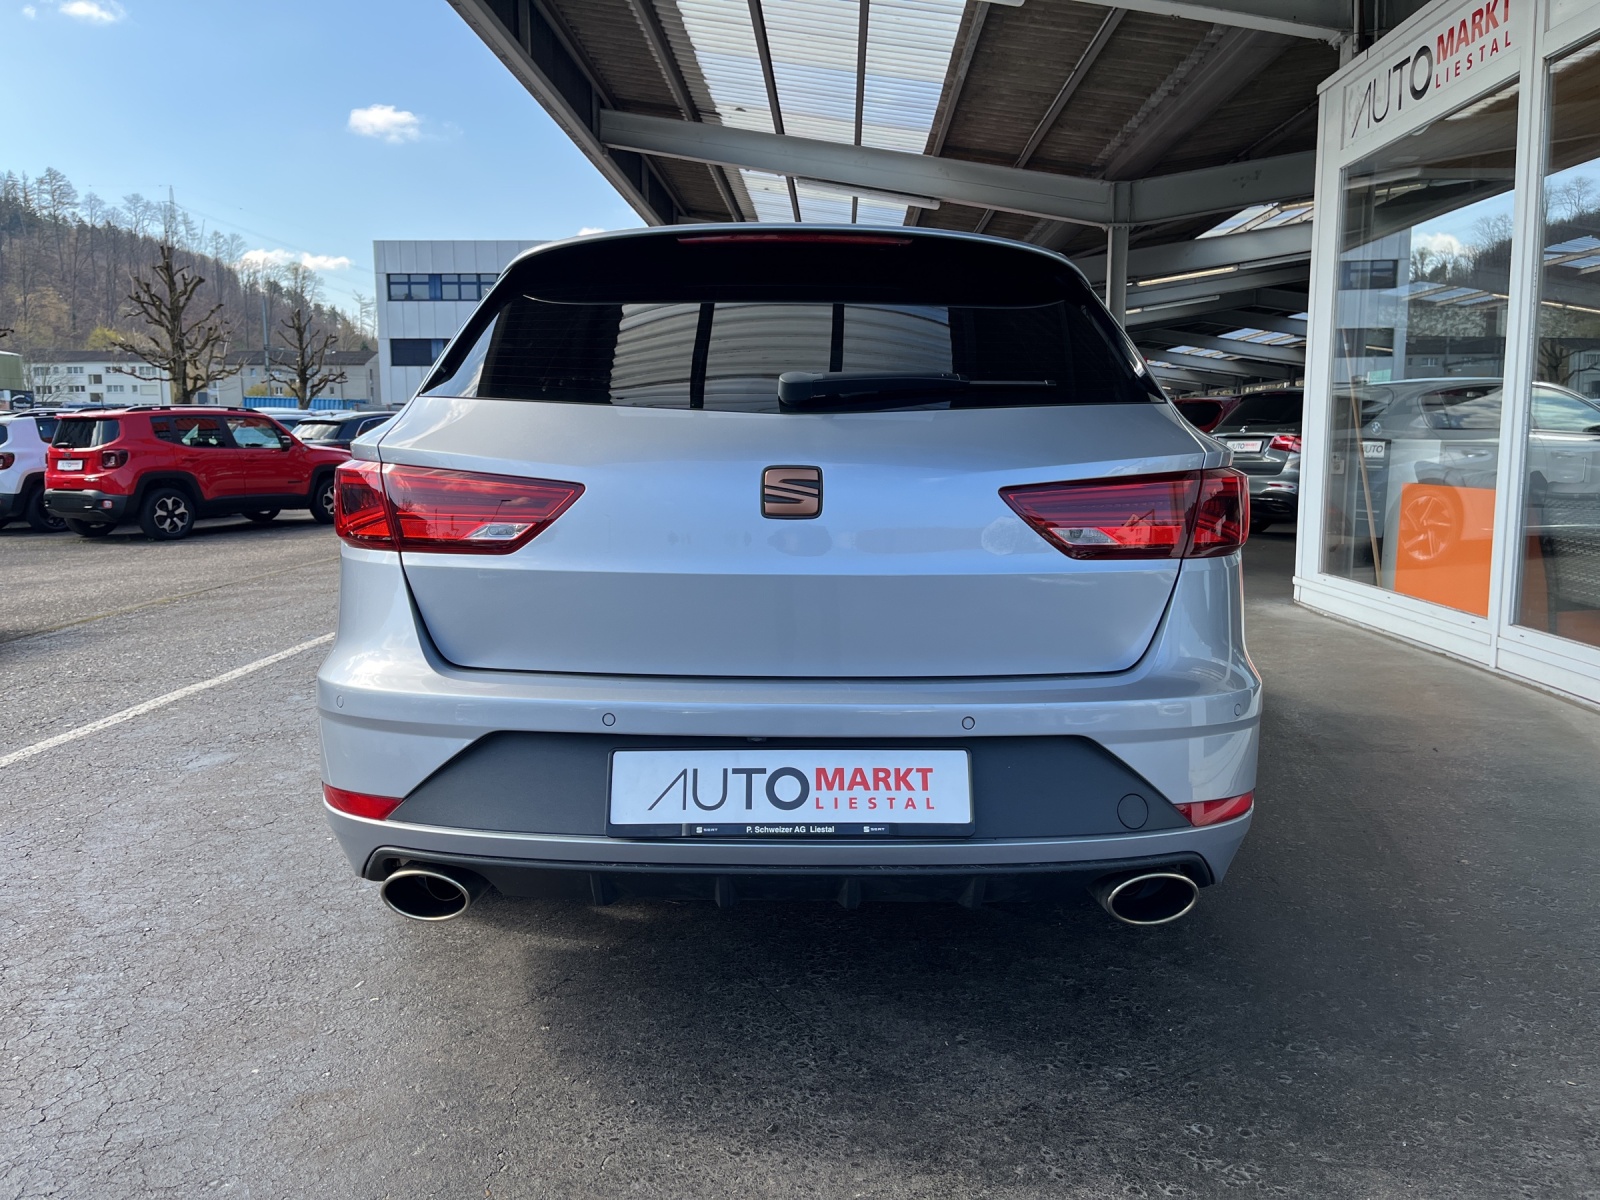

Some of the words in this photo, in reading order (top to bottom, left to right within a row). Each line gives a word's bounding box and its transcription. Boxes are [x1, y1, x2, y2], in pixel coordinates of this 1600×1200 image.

[1435, 31, 1511, 89] LIESTAL
[1351, 45, 1434, 139] AUTO
[647, 766, 810, 811] AUTO
[815, 767, 934, 791] MARKT
[815, 797, 935, 810] LIESTAL
[754, 825, 792, 833] Schweizer
[794, 825, 806, 833] AG
[809, 825, 835, 833] Liestal
